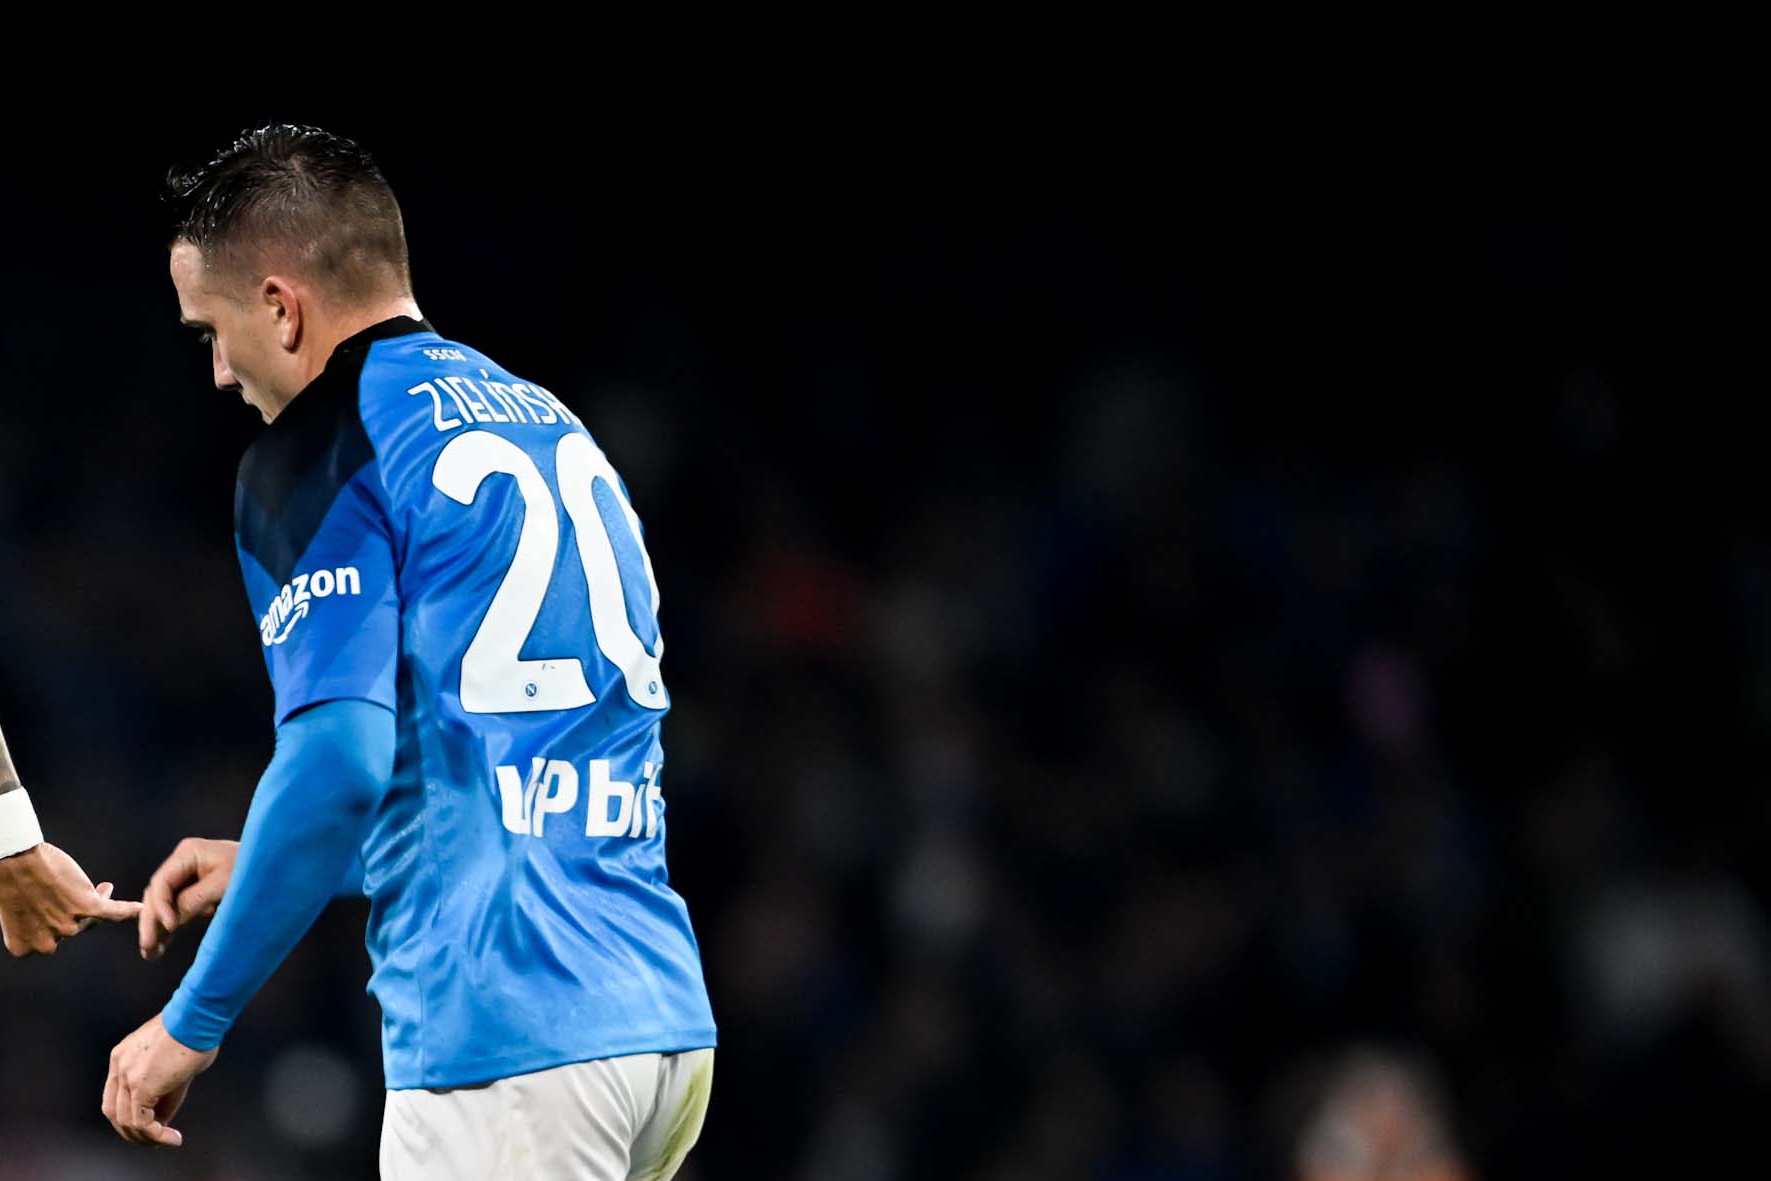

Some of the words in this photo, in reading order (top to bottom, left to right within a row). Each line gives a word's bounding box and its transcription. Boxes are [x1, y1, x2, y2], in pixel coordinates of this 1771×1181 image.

[407, 368, 582, 432] ZIELIŃSK
[260, 566, 361, 647] amazon
[432, 430, 669, 714] 20
